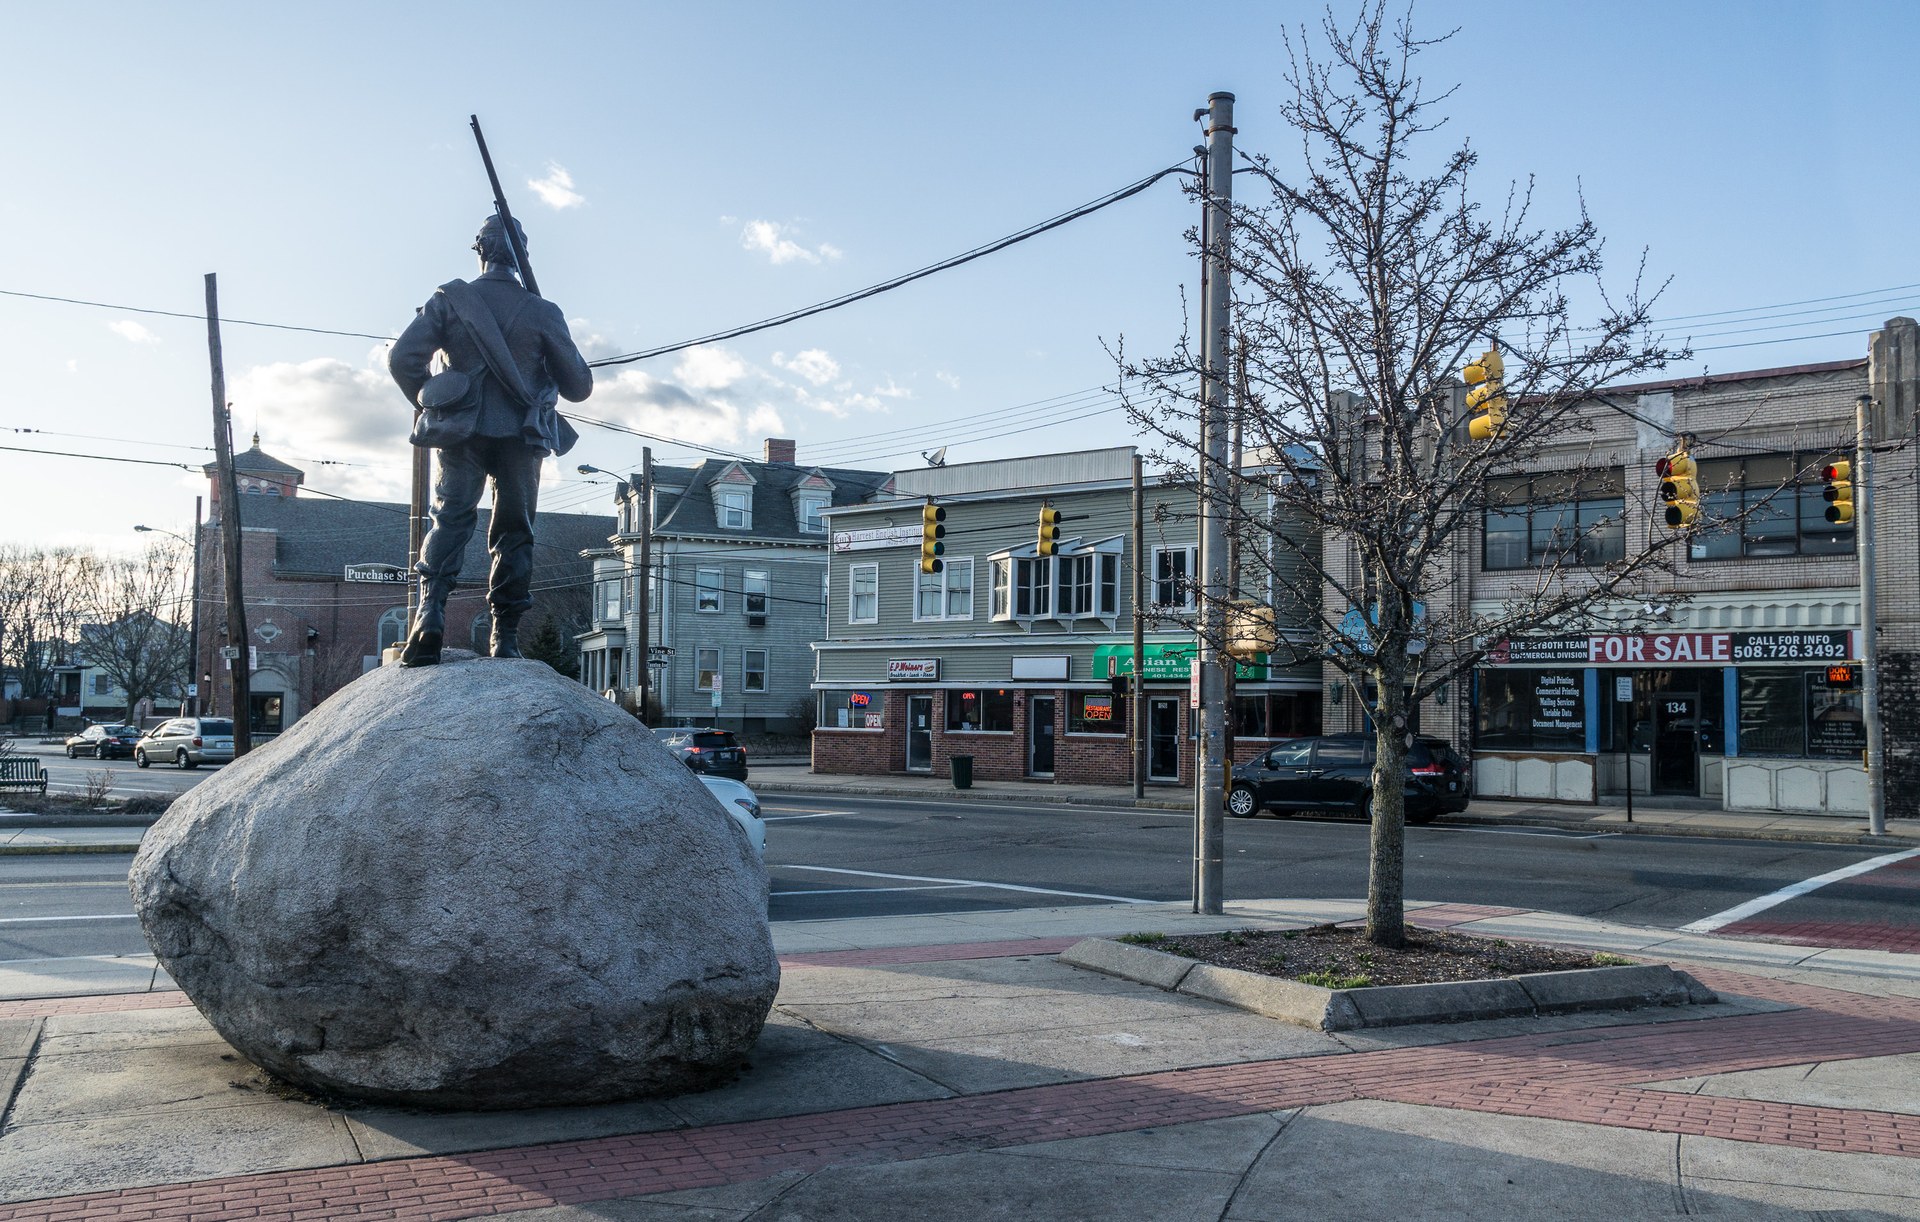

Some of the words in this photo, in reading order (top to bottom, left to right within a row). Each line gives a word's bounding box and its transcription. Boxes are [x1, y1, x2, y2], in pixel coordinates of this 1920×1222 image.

[347, 568, 395, 581] Purchase
[397, 570, 407, 581] St
[1564, 640, 1588, 649] TEAM
[1748, 636, 1775, 646] CALL
[1778, 635, 1800, 646] FOR
[1803, 634, 1830, 645] INFO
[1588, 636, 1645, 662] FOR
[1653, 635, 1730, 661] SALE
[1734, 645, 1845, 658] 508.726.3492
[1556, 651, 1588, 659] DIVISION
[1540, 675, 1556, 686] Digital
[1556, 675, 1574, 686] Printing
[1830, 673, 1851, 682] WALK
[962, 692, 975, 700] OPEN
[1535, 686, 1561, 695] Commercial
[1561, 686, 1580, 697] Printing
[850, 693, 870, 705] OPEN
[1539, 697, 1556, 707] Mailing
[1556, 697, 1575, 706] Services
[1542, 708, 1561, 717] Variable
[1561, 708, 1572, 717] Data
[1665, 702, 1687, 713] 134
[865, 714, 881, 727] OPEN
[1085, 710, 1111, 720] OPEN
[1532, 718, 1554, 728] Document
[1554, 719, 1583, 730] Management
